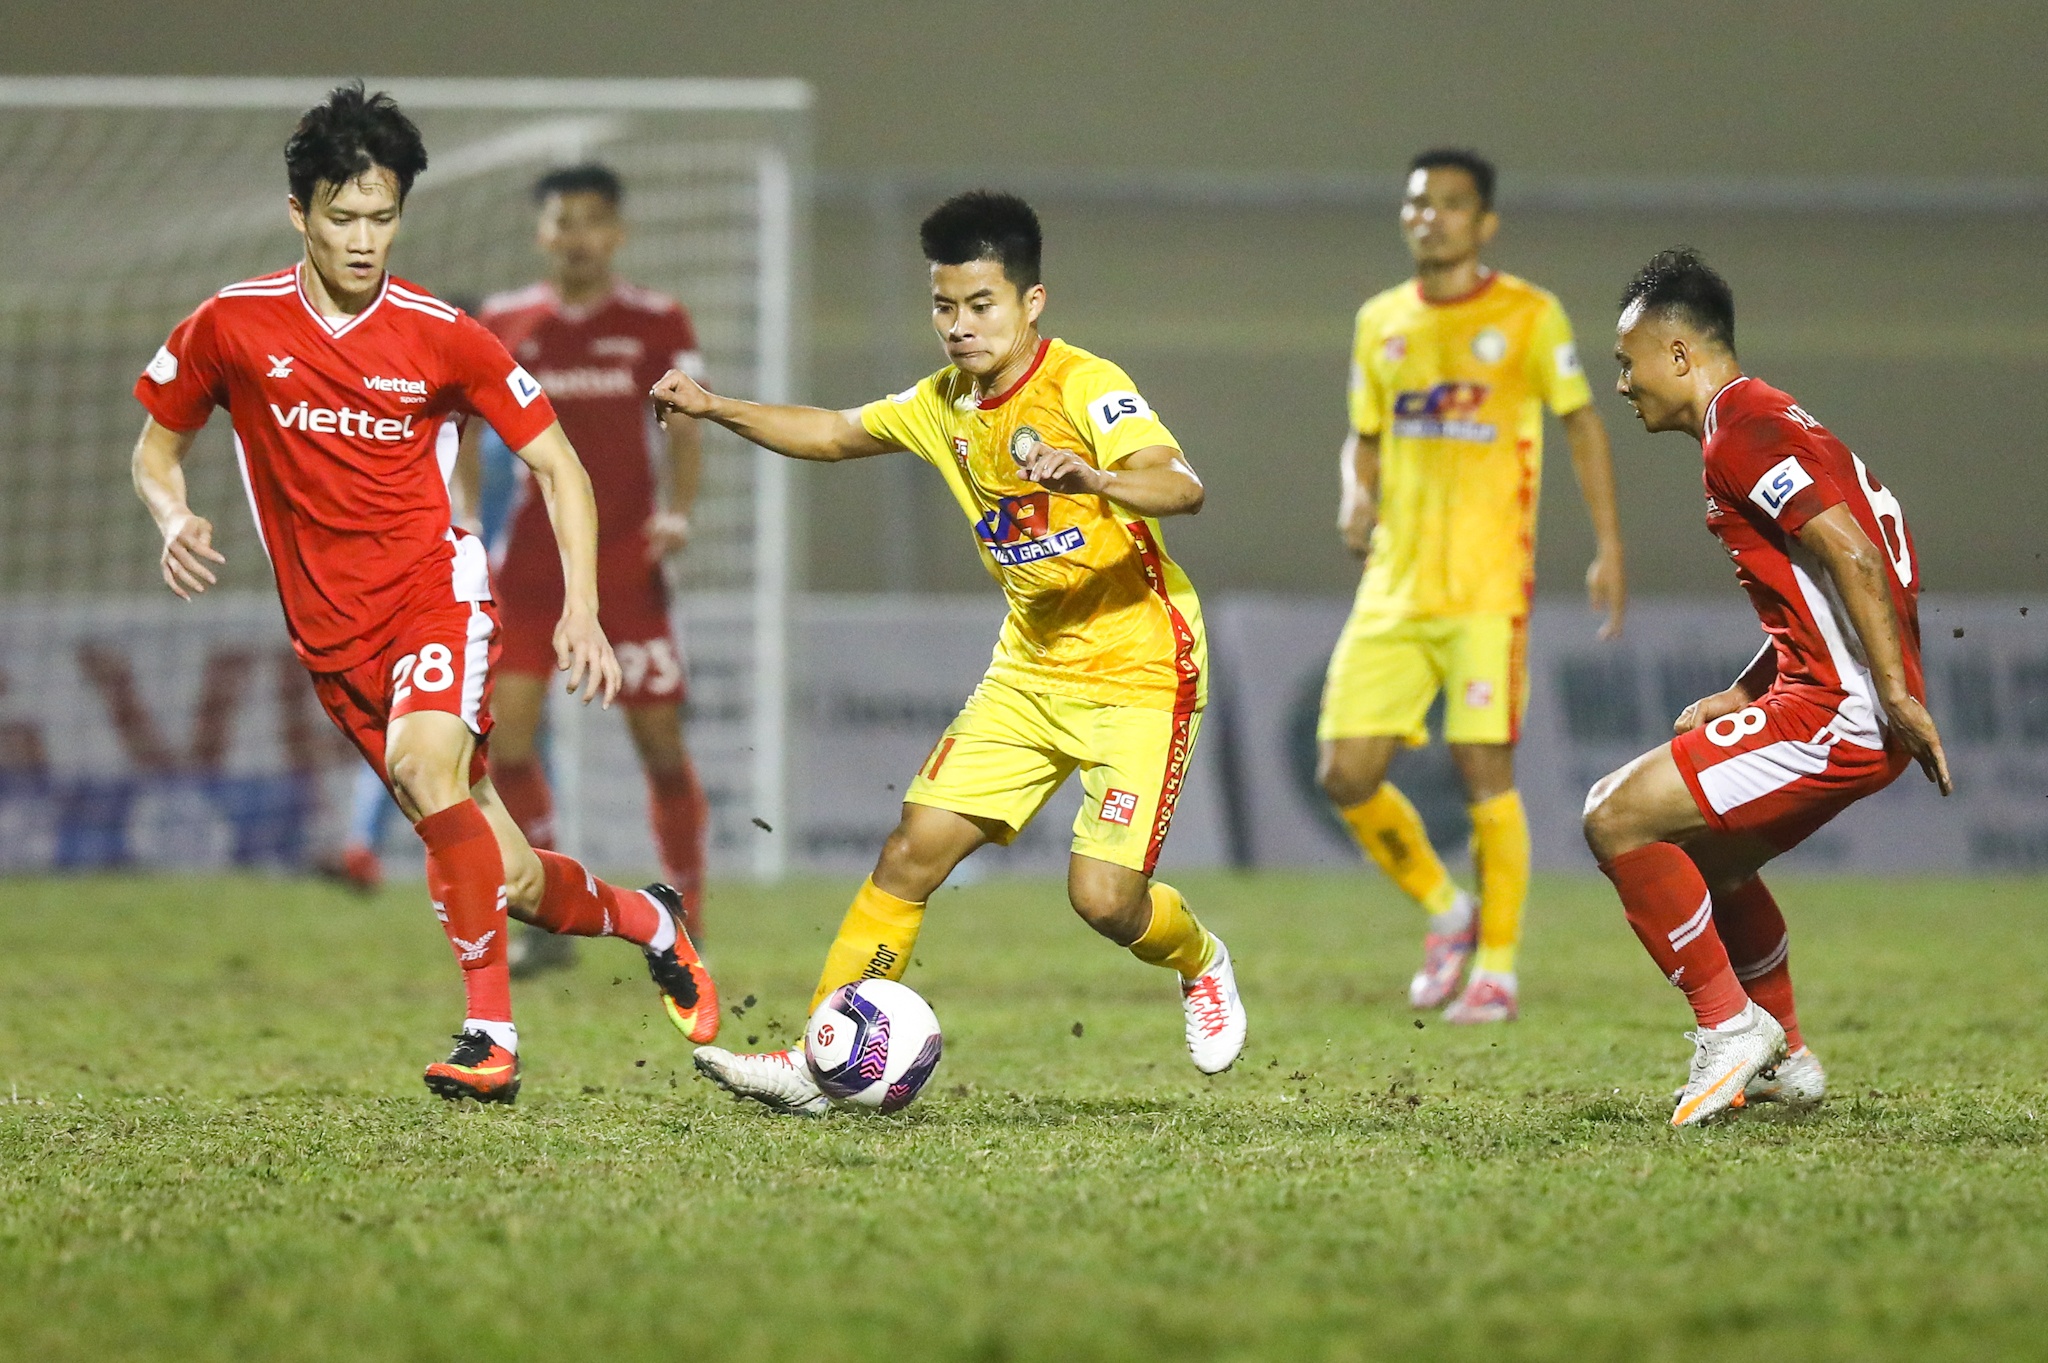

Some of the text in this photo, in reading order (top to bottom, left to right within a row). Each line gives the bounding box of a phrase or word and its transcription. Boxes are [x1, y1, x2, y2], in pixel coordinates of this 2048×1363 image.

[363, 375, 427, 394] viettel
[270, 401, 415, 441] viettel
[1103, 398, 1137, 424] LS
[1762, 471, 1794, 508] LS
[392, 642, 455, 708] 28
[1705, 706, 1767, 747] 8
